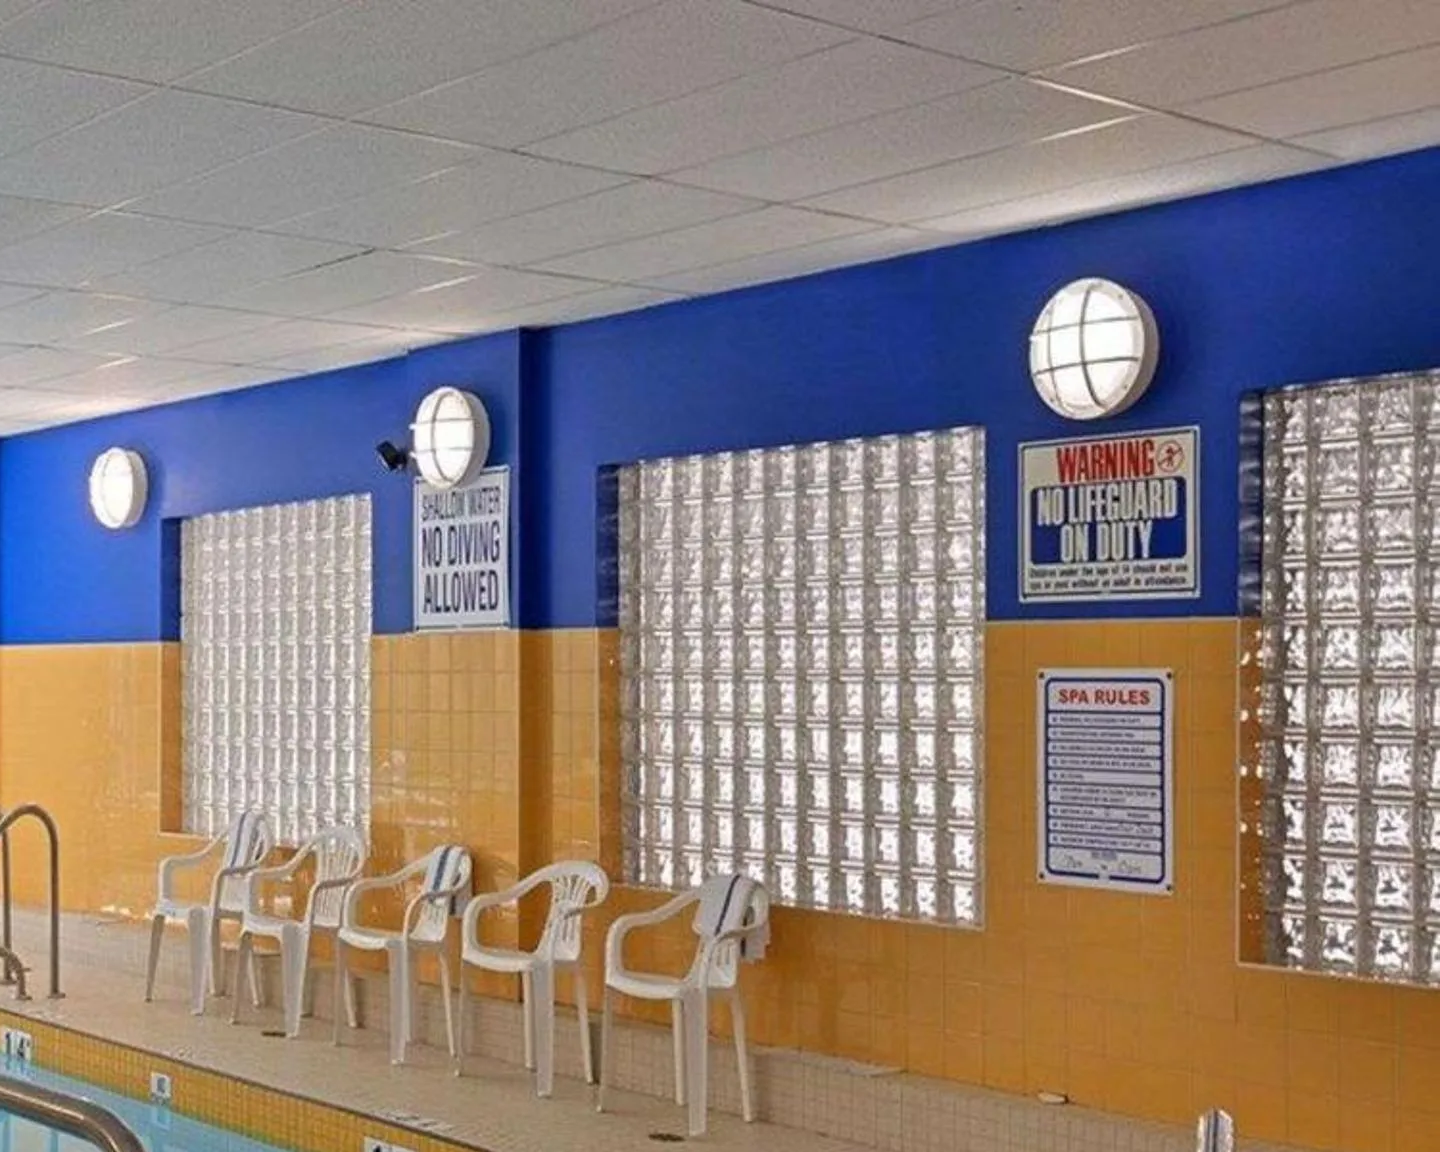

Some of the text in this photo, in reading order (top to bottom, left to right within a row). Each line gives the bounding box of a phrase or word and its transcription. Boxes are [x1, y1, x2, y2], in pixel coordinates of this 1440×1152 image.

[1056, 439, 1155, 483] WARNING
[422, 486, 501, 521] SHALLOW WATER
[1037, 479, 1178, 526] NO LIFEGUARD
[422, 520, 501, 568] NO DIVING
[1061, 519, 1153, 563] ON DUTY
[423, 569, 499, 614] ALLOWED
[1059, 688, 1151, 705] SPA RULES
